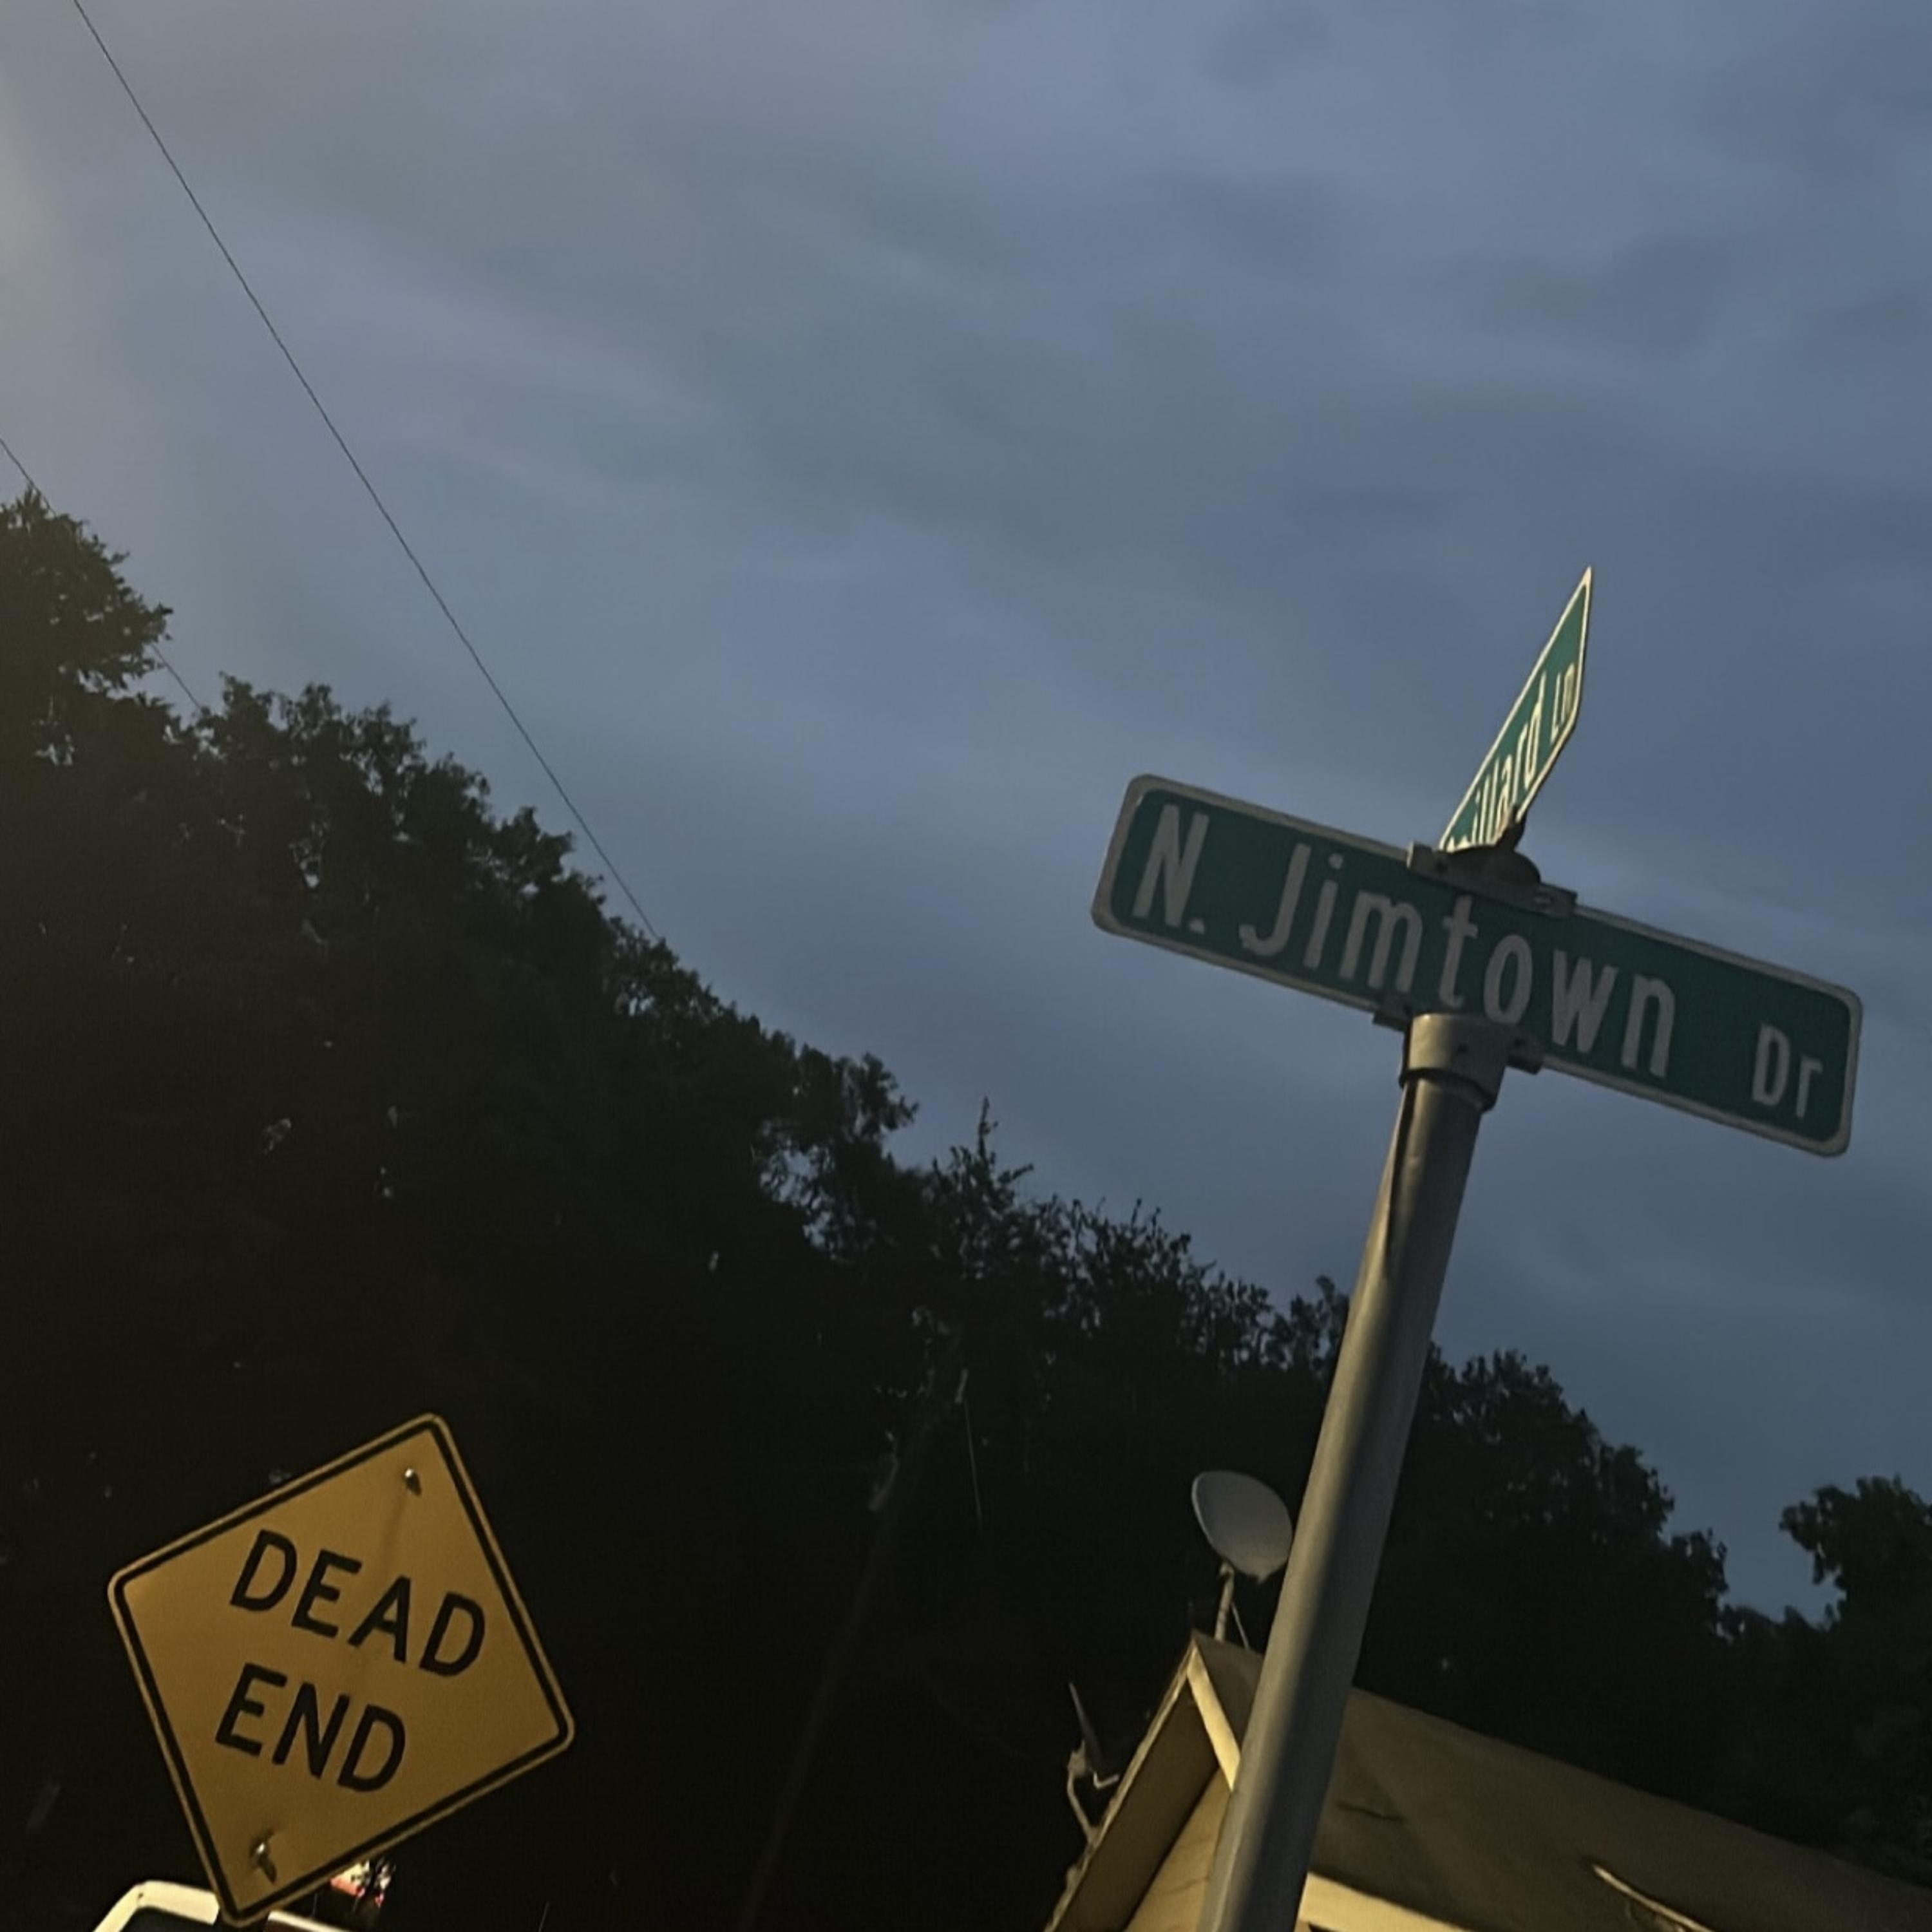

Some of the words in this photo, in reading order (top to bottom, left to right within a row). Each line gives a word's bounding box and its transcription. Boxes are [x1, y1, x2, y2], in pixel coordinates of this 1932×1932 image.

[1551, 663, 1575, 743] Ln
[1132, 804, 1209, 934] N.
[1238, 842, 1676, 1078] Jimtown
[1752, 1022, 1823, 1119] Dr
[229, 1528, 486, 1677] DEAD
[214, 1662, 406, 1793] END
